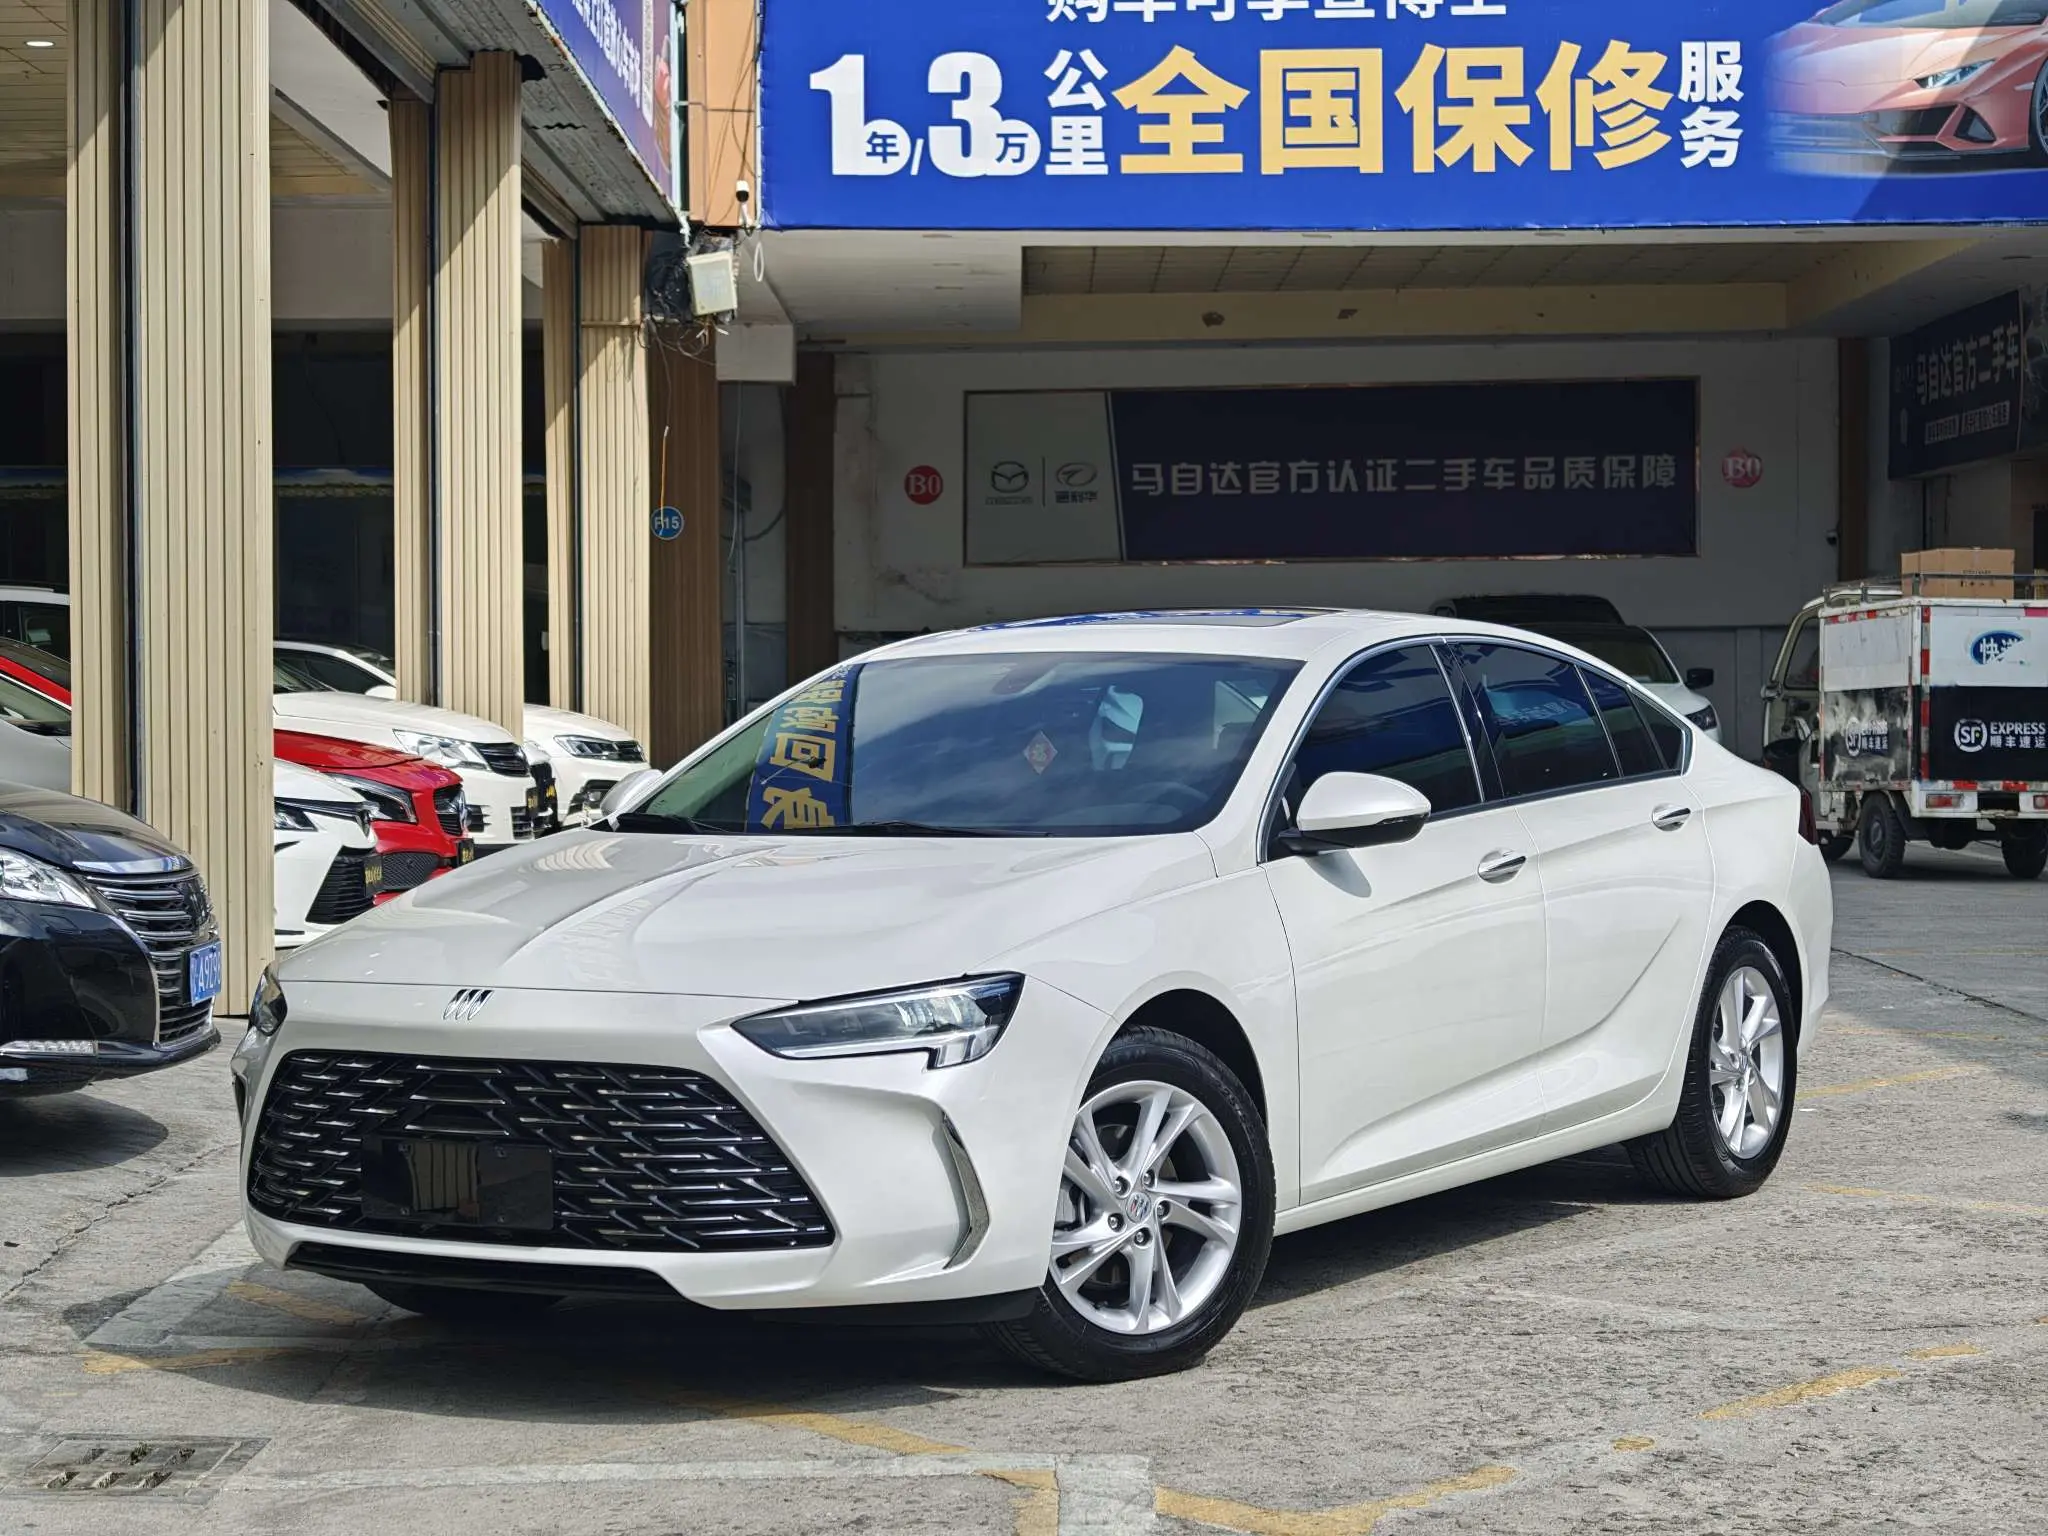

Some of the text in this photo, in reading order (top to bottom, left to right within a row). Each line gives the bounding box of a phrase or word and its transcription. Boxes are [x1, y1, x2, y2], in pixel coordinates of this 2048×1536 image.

[1132, 454, 1677, 496] 马自达官方认证二手车品质保障
[1990, 722, 2046, 735] EXPRESS
